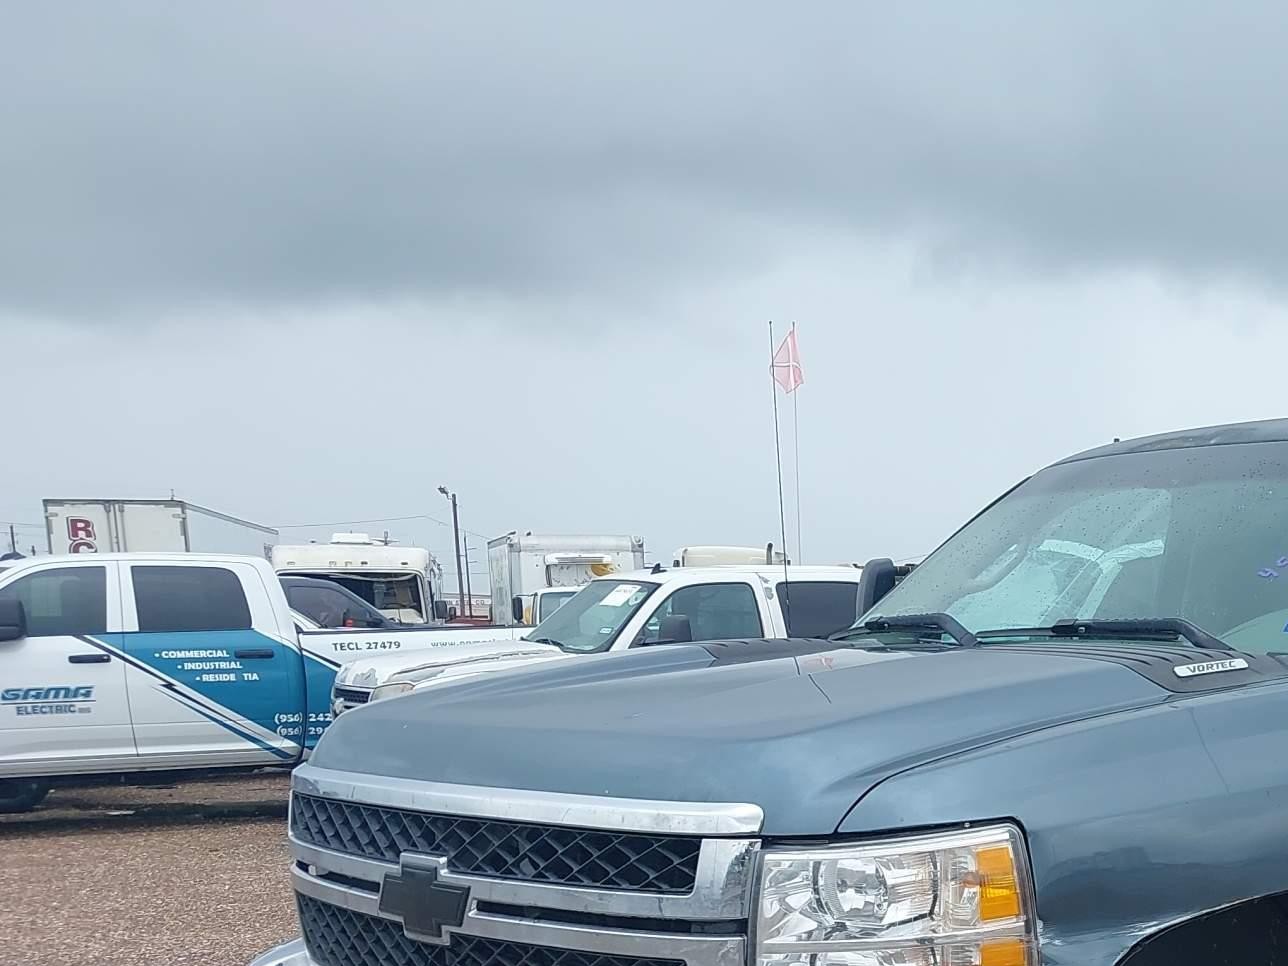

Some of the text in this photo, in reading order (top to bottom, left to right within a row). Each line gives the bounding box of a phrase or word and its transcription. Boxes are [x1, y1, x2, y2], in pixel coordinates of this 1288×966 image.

[332, 640, 401, 651] TECL 27479
[161, 649, 230, 659] COMMERCIAL
[183, 661, 243, 670] INDUSTRIAL
[1186, 660, 1237, 674] VORTEC
[16, 704, 76, 716] ELECTRIC
